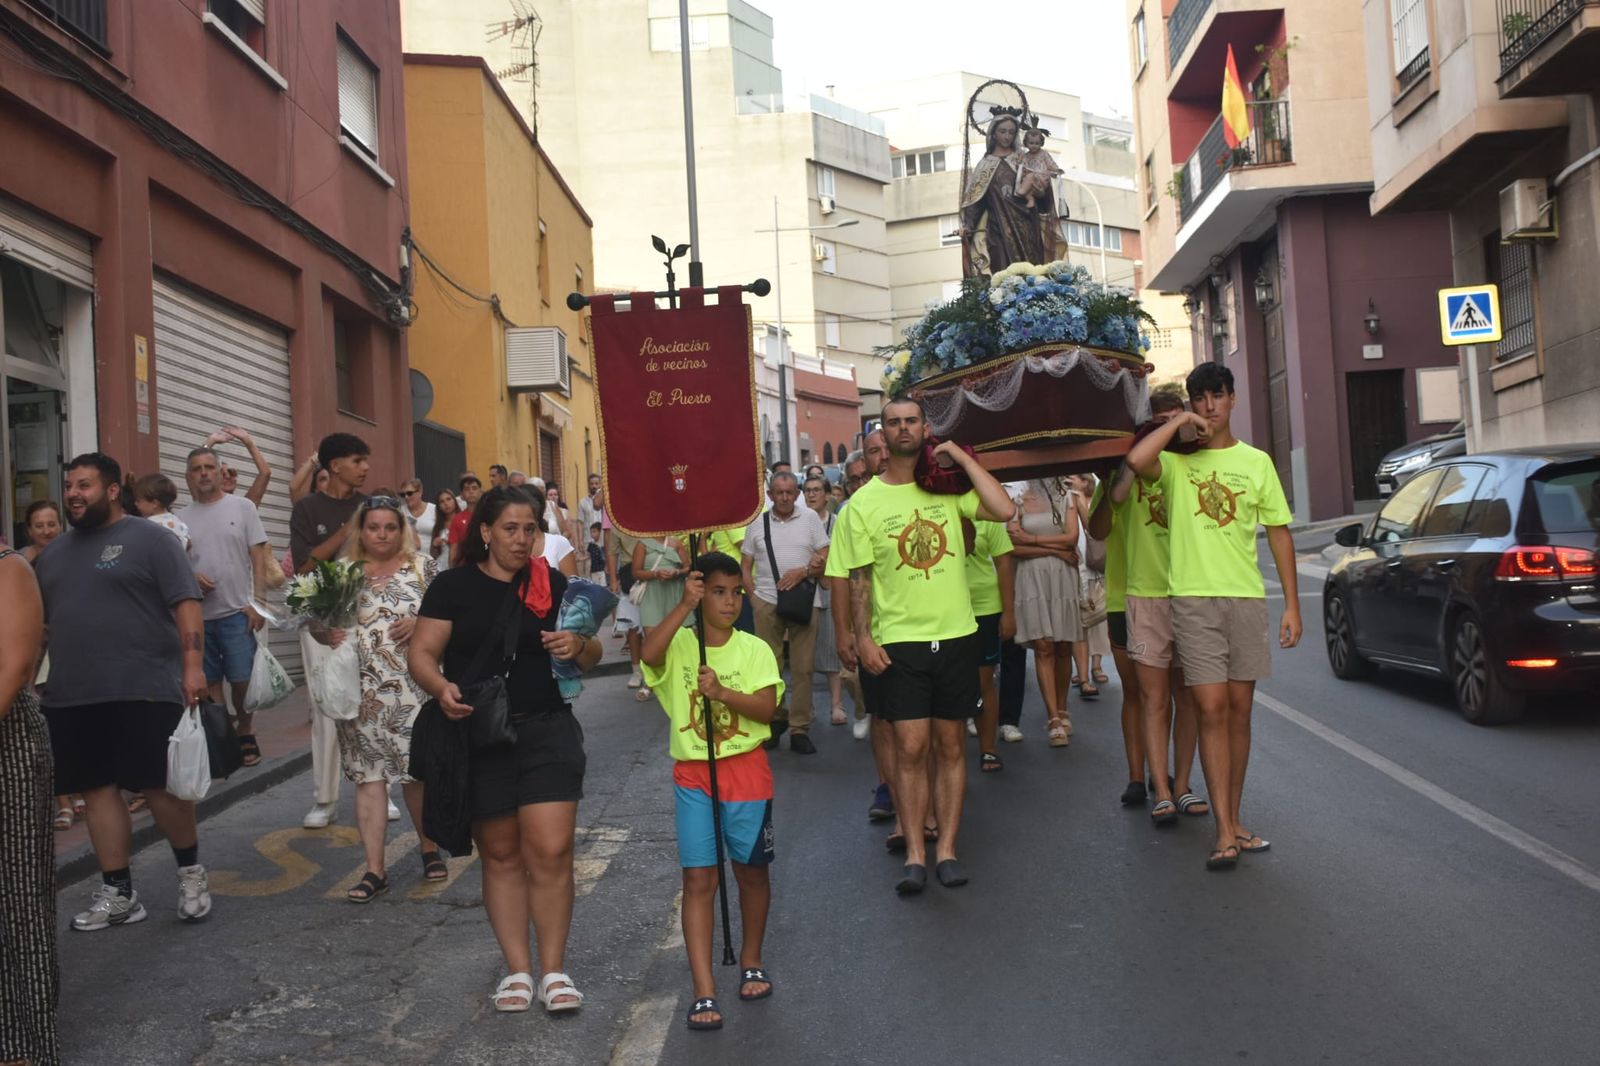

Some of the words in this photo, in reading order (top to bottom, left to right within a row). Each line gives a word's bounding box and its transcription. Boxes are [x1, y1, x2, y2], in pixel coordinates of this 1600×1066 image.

[640, 336, 711, 356] Asociación
[646, 358, 660, 372] de
[663, 357, 708, 371] vecinos
[646, 390, 663, 408] El
[667, 387, 712, 406] Puerto
